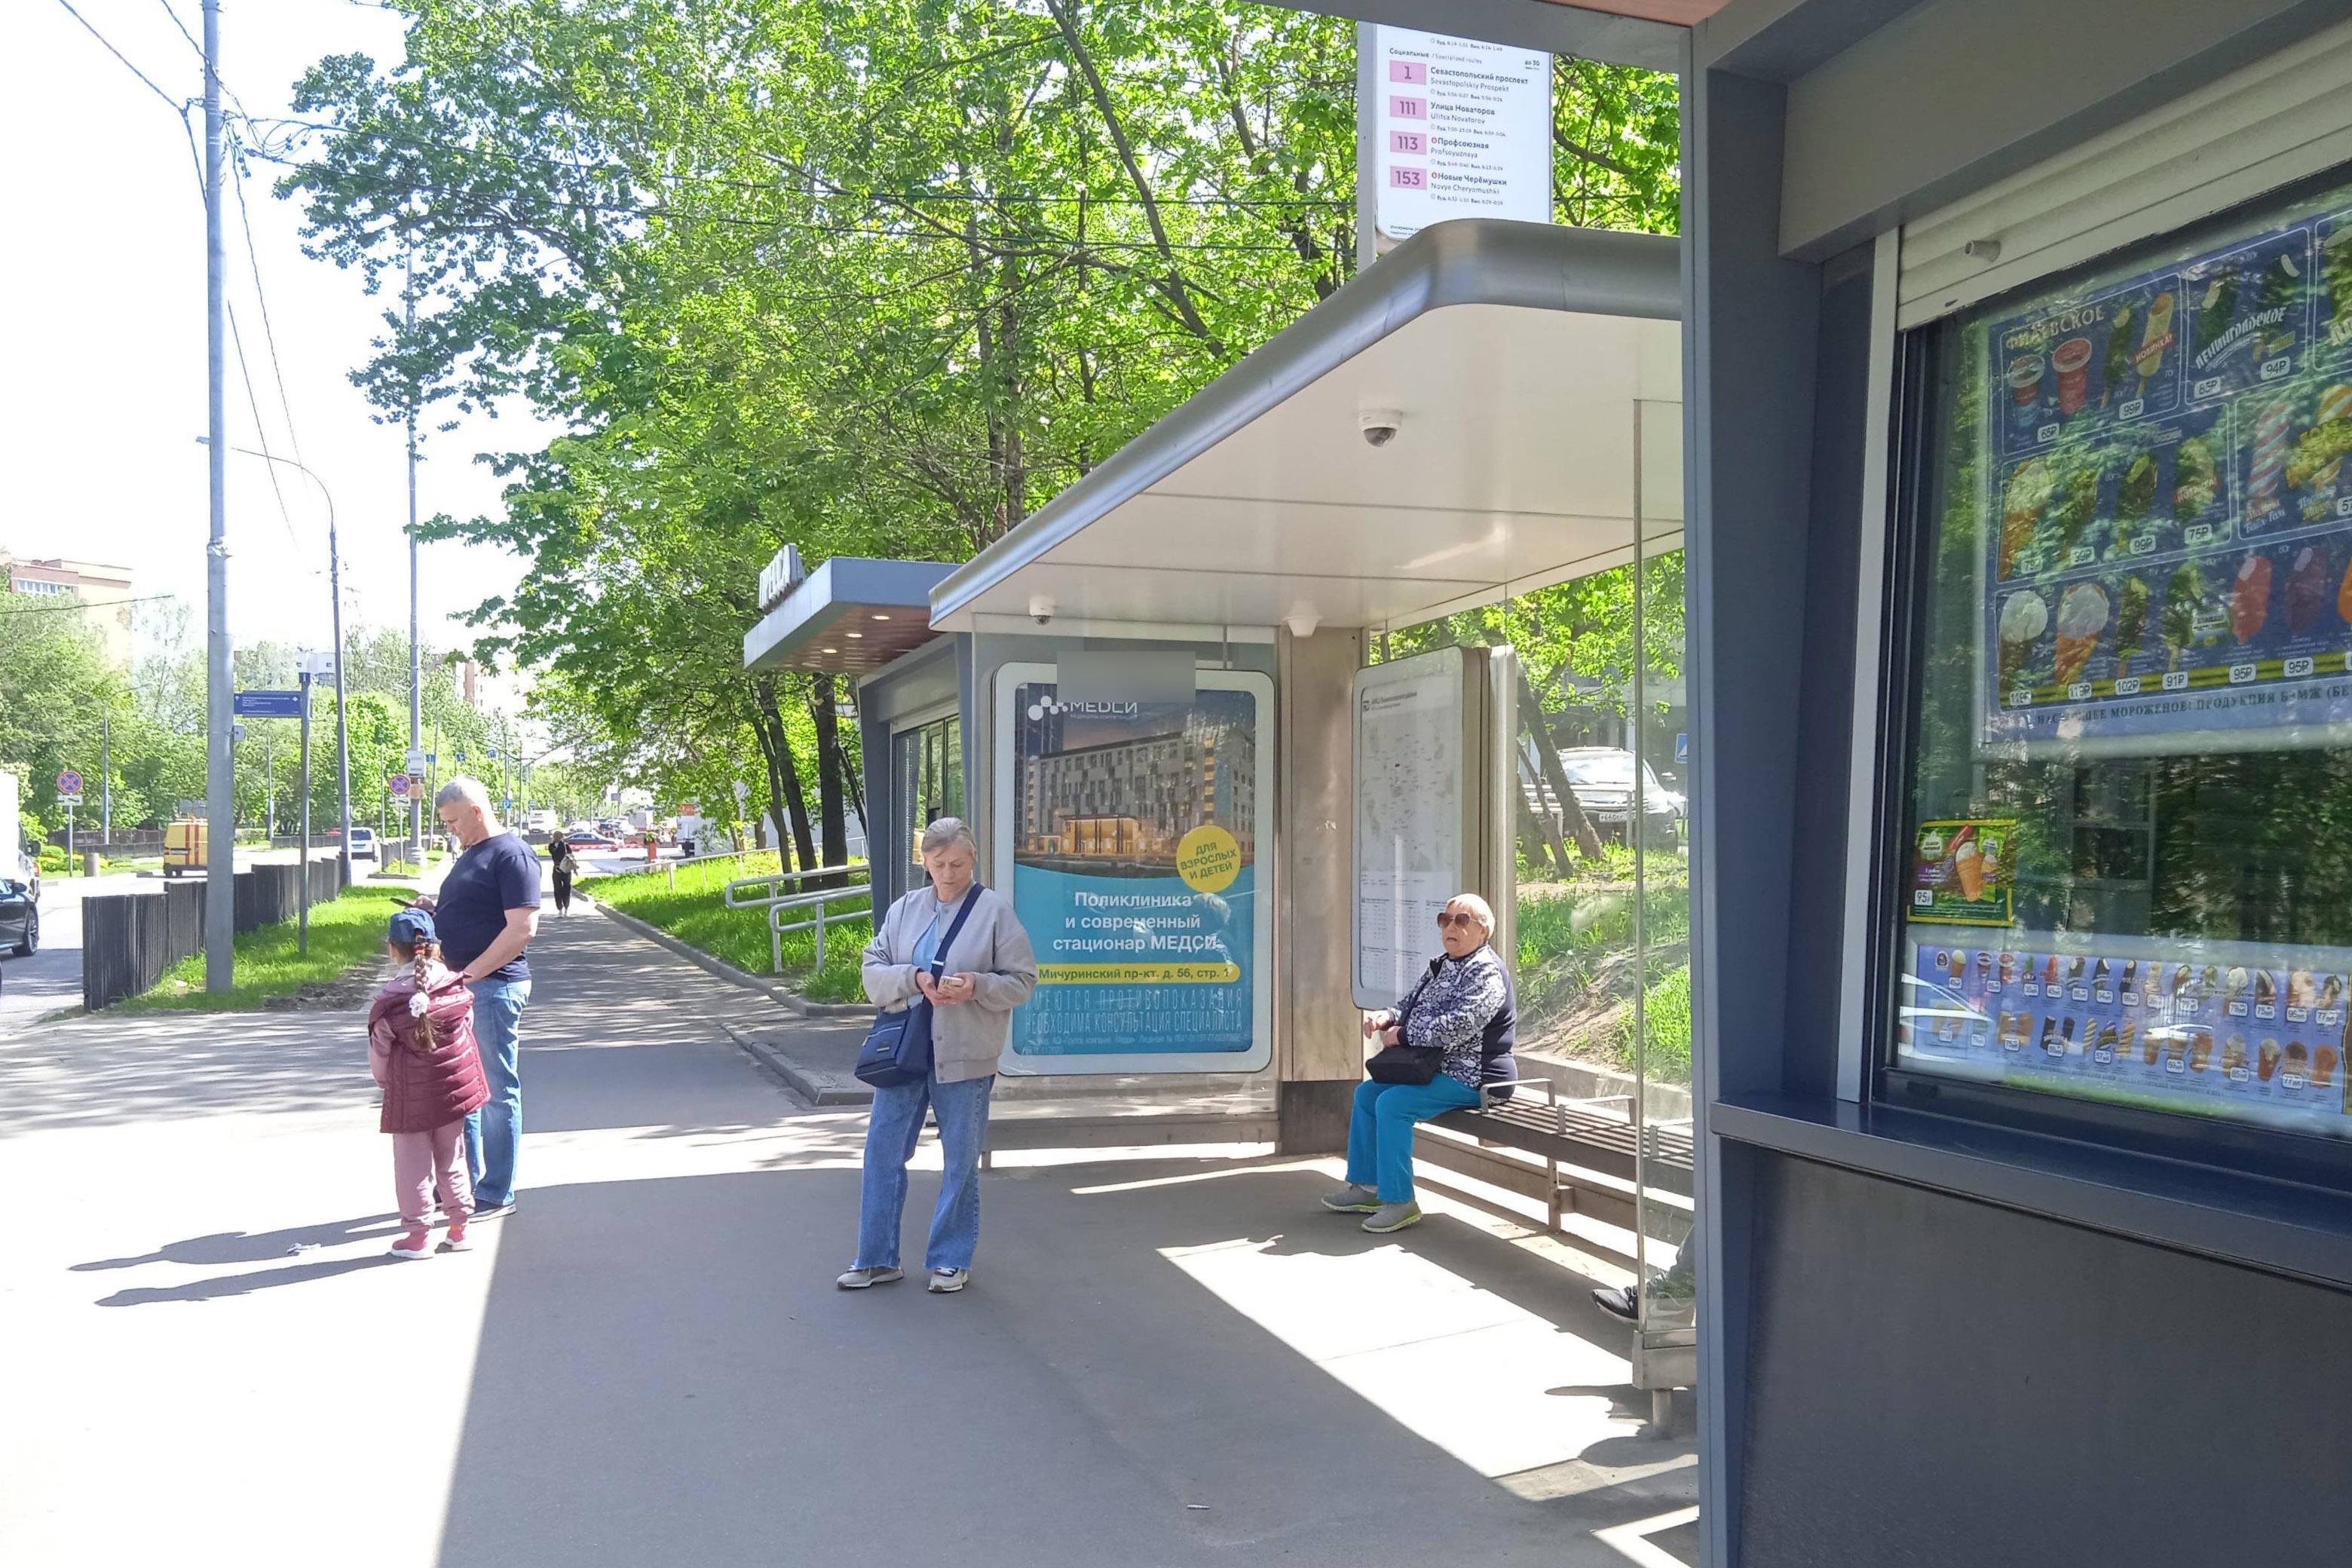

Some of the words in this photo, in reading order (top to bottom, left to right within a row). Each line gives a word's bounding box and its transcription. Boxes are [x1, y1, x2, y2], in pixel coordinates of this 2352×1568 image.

[1389, 47, 1429, 57] Социальные
[1404, 66, 1412, 80] 1
[1430, 66, 1494, 81] Севастопольский
[1495, 75, 1529, 84] проспект
[1430, 78, 1479, 90] Sevastopolskiy
[1480, 83, 1509, 92] Prospekt
[1399, 100, 1416, 115] 111
[1430, 102, 1453, 112] Улица
[1455, 103, 1496, 115] Новаторов
[1431, 113, 1450, 121] Ulitsa
[1451, 115, 1486, 124] Novatorov
[1398, 136, 1419, 151] 113
[1438, 136, 1490, 149] Профсоюзная
[1431, 147, 1478, 159] Profsoyuznaya
[1395, 170, 1420, 185] 153
[1438, 171, 1463, 182] Новые
[1464, 174, 1507, 186] Черёмушки
[1452, 184, 1500, 194] Cheryomushki
[2195, 306, 2287, 369] ЛЕНИНГРАДСКОЕ
[2195, 691, 2275, 710] ПРОДУКЦИЯ
[1196, 842, 1217, 856] ДЛЯ
[1181, 849, 1237, 870] ВЗРОСЛЫХ
[1190, 871, 1198, 879] И
[1200, 859, 1233, 879] ДЕТЕЙ
[1075, 892, 1193, 907] Поликлиника
[1065, 917, 1076, 929] и
[1081, 914, 1201, 931] современный
[1052, 937, 1146, 953] стационар
[1150, 935, 1218, 953] МЕДСИ
[1039, 967, 1121, 982] Мичуринский
[1162, 969, 1173, 980] д.
[1177, 968, 1194, 980] 56,
[1196, 968, 1220, 982] стр.
[1099, 988, 1242, 1011] ПРОТИВОПОКАЗАНИЯ
[1025, 1012, 1091, 1035] НЕОБХОДИМА
[1095, 1010, 1171, 1034] КОНСУЛЬТАЦИЯ
[1174, 1009, 1242, 1033] СПЕЦИАЛИСТА
